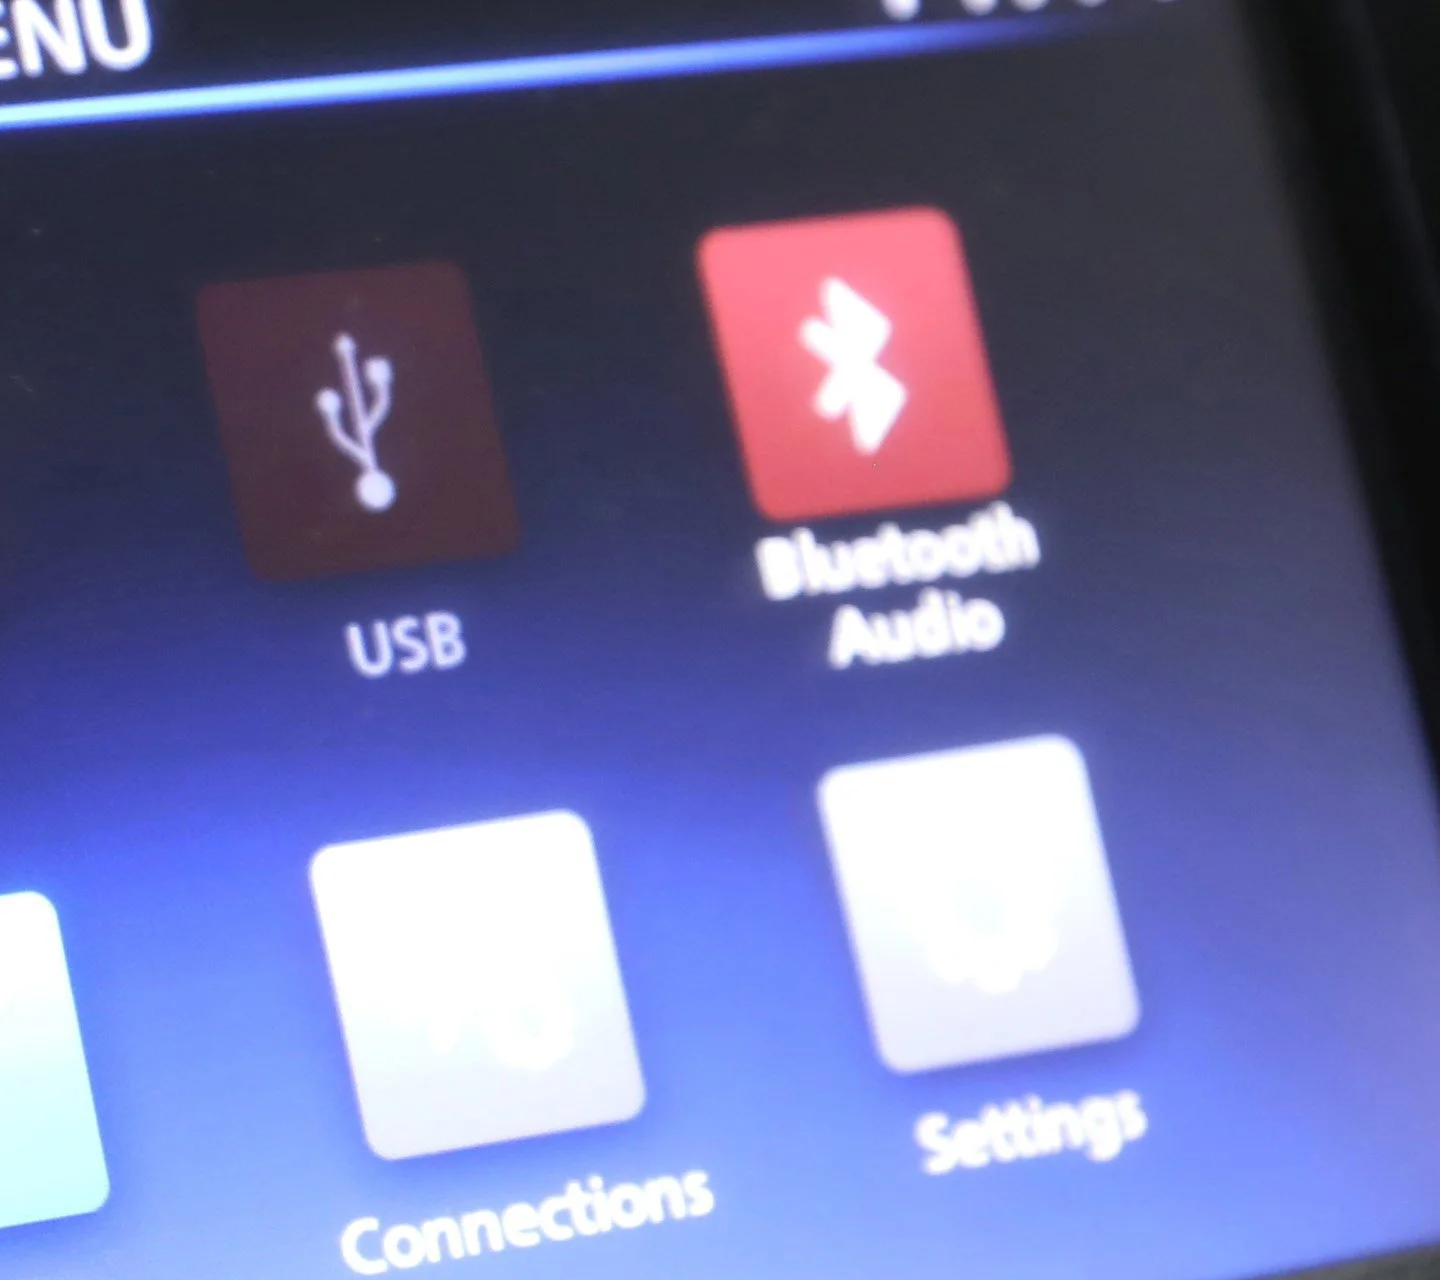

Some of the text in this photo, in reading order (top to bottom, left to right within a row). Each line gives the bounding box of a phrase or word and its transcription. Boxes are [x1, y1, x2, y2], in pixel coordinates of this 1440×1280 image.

[757, 502, 1040, 601] Bluetooth
[345, 612, 467, 677] USB
[829, 589, 1004, 670] Audio
[915, 1088, 1148, 1175] Settings
[339, 1167, 716, 1276] Connections
